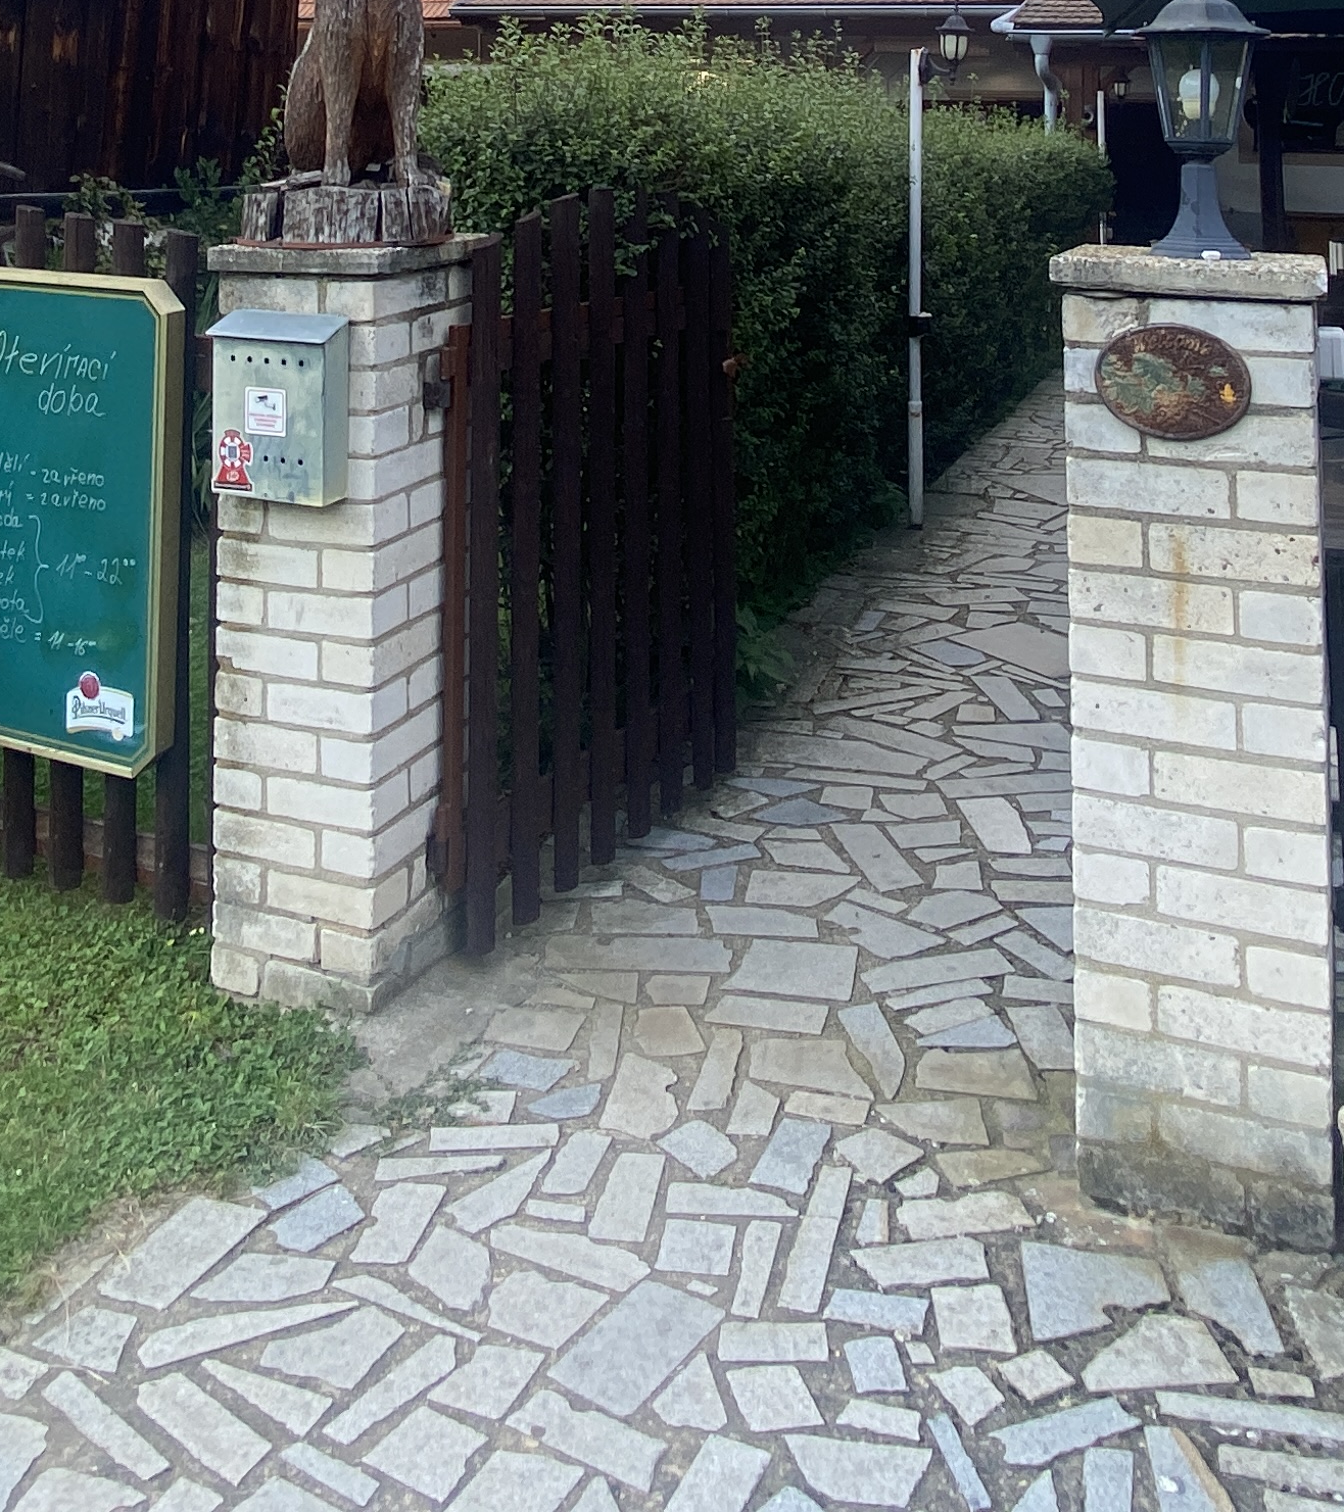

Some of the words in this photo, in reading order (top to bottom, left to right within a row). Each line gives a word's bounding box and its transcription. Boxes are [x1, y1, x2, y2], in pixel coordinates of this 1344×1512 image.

[38, 382, 106, 417] doba
[41, 467, 104, 487] zavřeno
[40, 490, 107, 511] zavřeno
